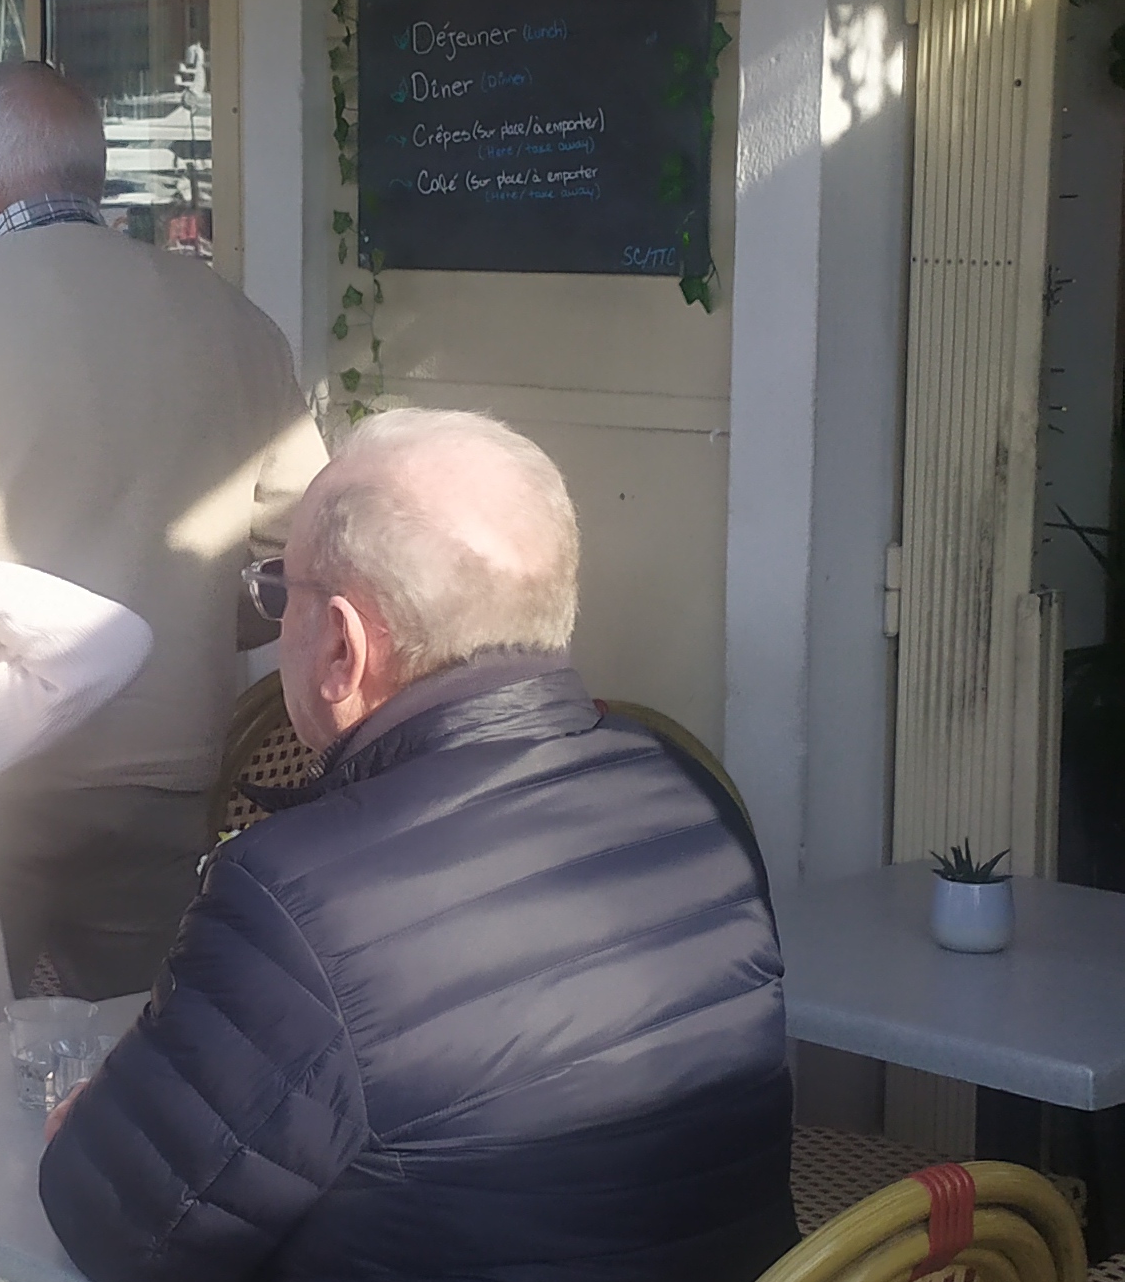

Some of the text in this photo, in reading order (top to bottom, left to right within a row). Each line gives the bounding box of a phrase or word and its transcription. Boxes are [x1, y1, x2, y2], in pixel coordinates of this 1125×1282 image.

[412, 19, 568, 61] Déjeuner (Lunch)
[417, 169, 459, 195] Café
[546, 165, 599, 186] emporter
